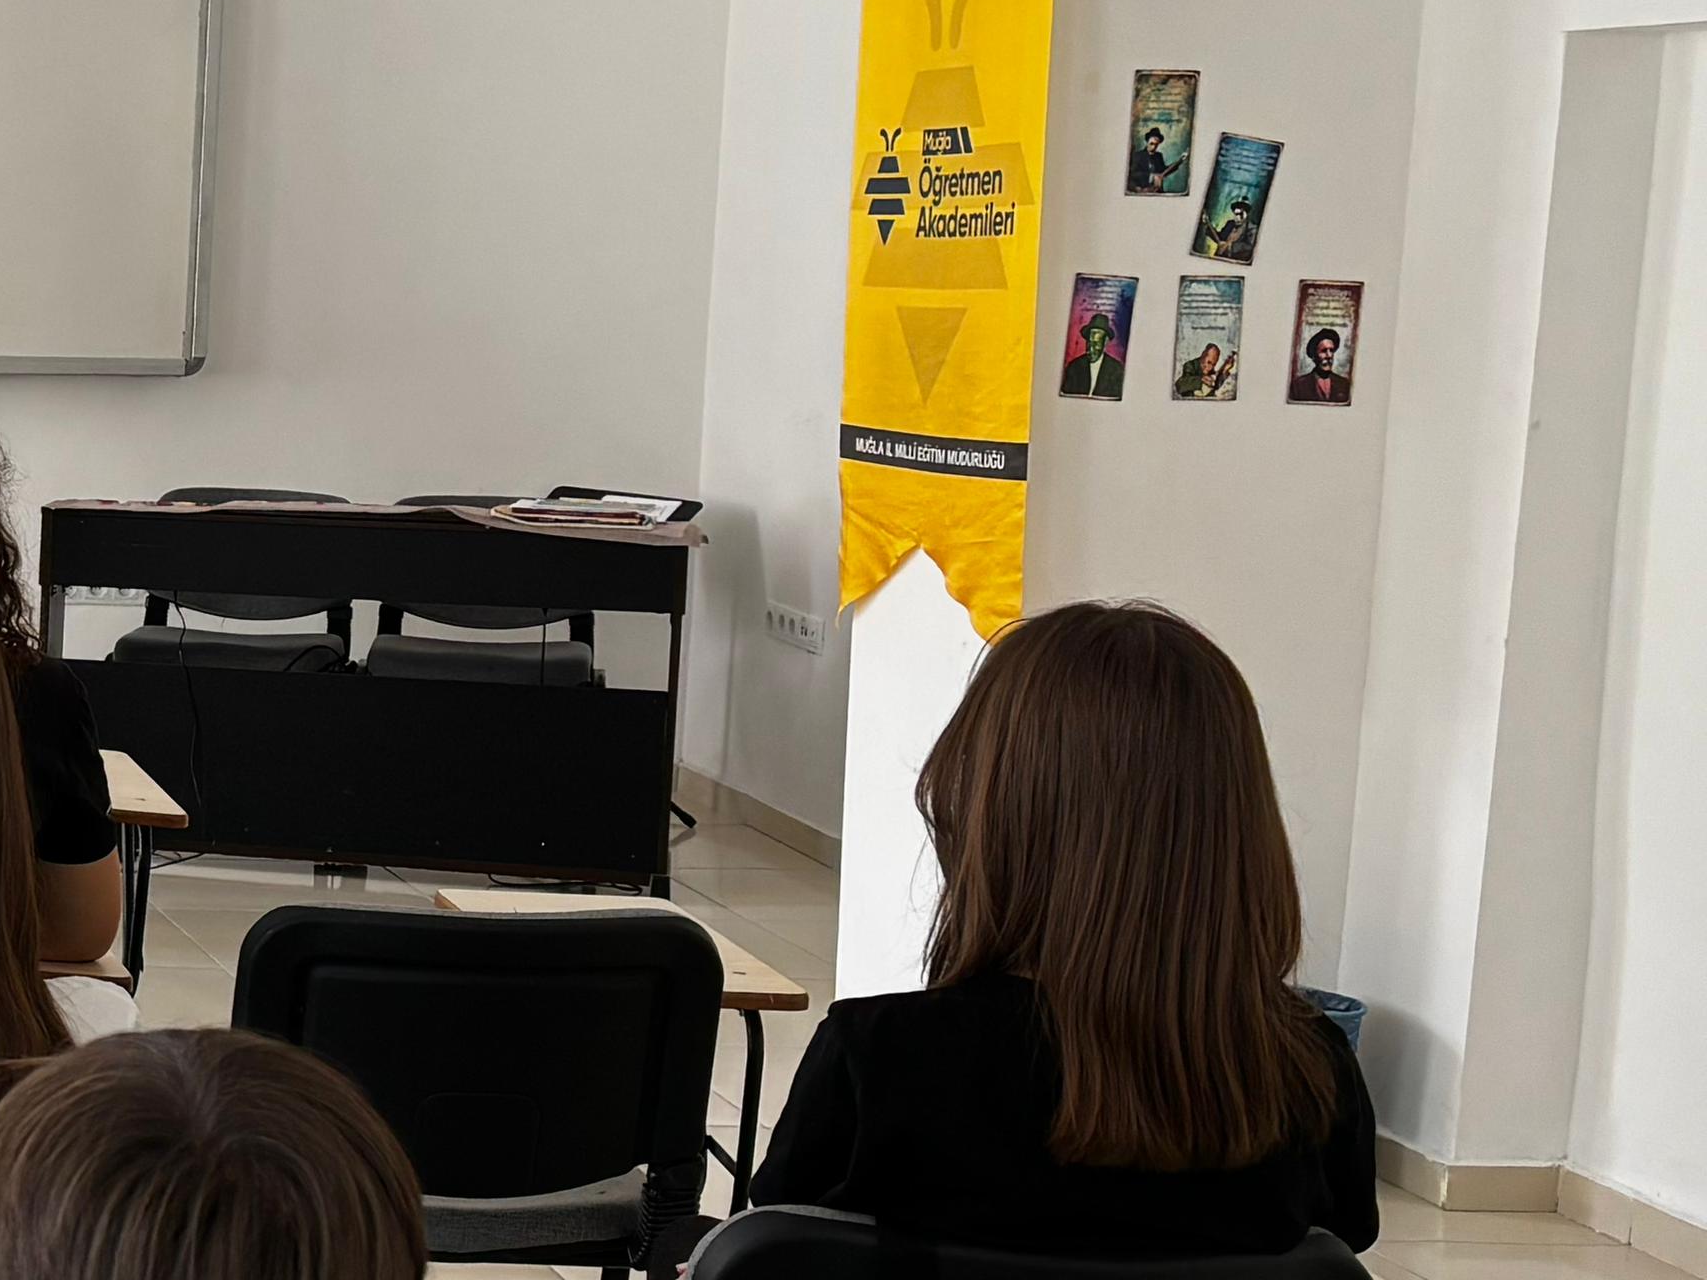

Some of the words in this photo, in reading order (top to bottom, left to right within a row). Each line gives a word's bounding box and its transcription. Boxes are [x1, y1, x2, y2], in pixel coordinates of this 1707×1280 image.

[924, 131, 952, 155] Muğla
[919, 157, 1003, 207] Öğretmen
[915, 201, 1016, 238] Akademileri
[856, 435, 884, 455] MUĞLA
[917, 443, 946, 464] EĞİTİM
[946, 447, 1006, 470] MÜDÜRLÜĞÜ
